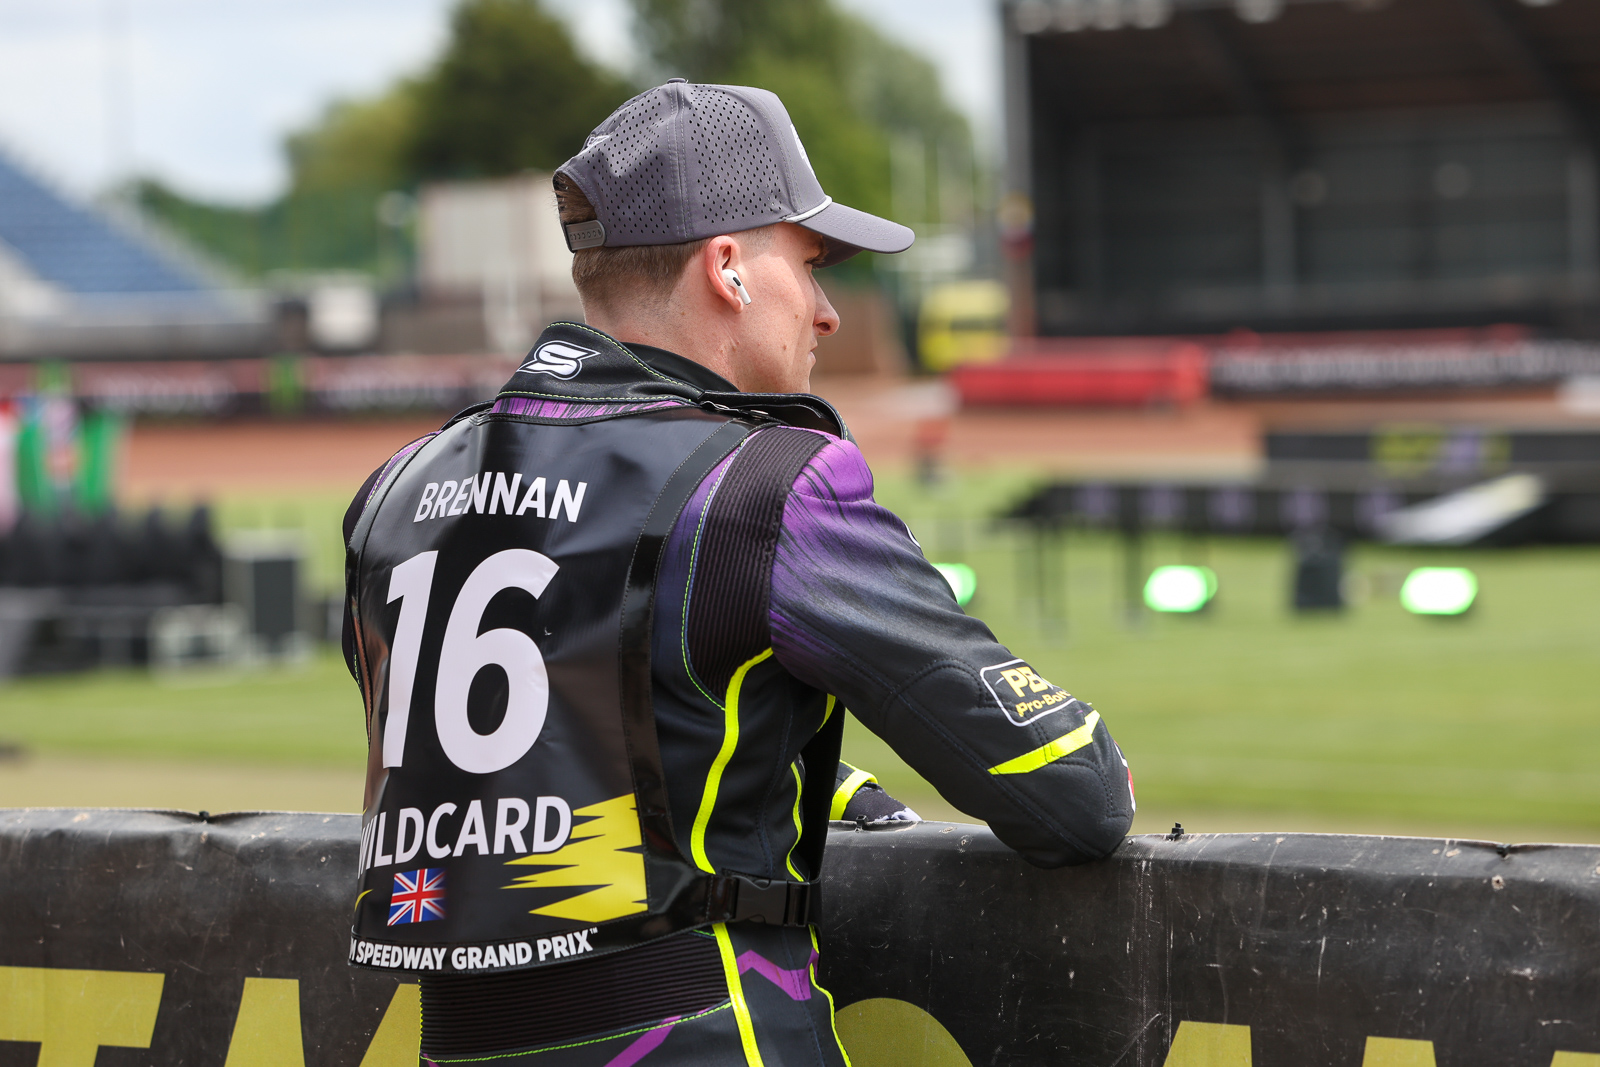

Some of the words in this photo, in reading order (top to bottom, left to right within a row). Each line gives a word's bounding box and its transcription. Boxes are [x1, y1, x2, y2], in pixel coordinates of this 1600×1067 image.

[413, 471, 588, 523] BRENNAN
[382, 548, 560, 774] 16
[357, 796, 572, 880] WILDCARD
[355, 941, 447, 970] SPEEDWAY
[451, 942, 533, 970] GRAND
